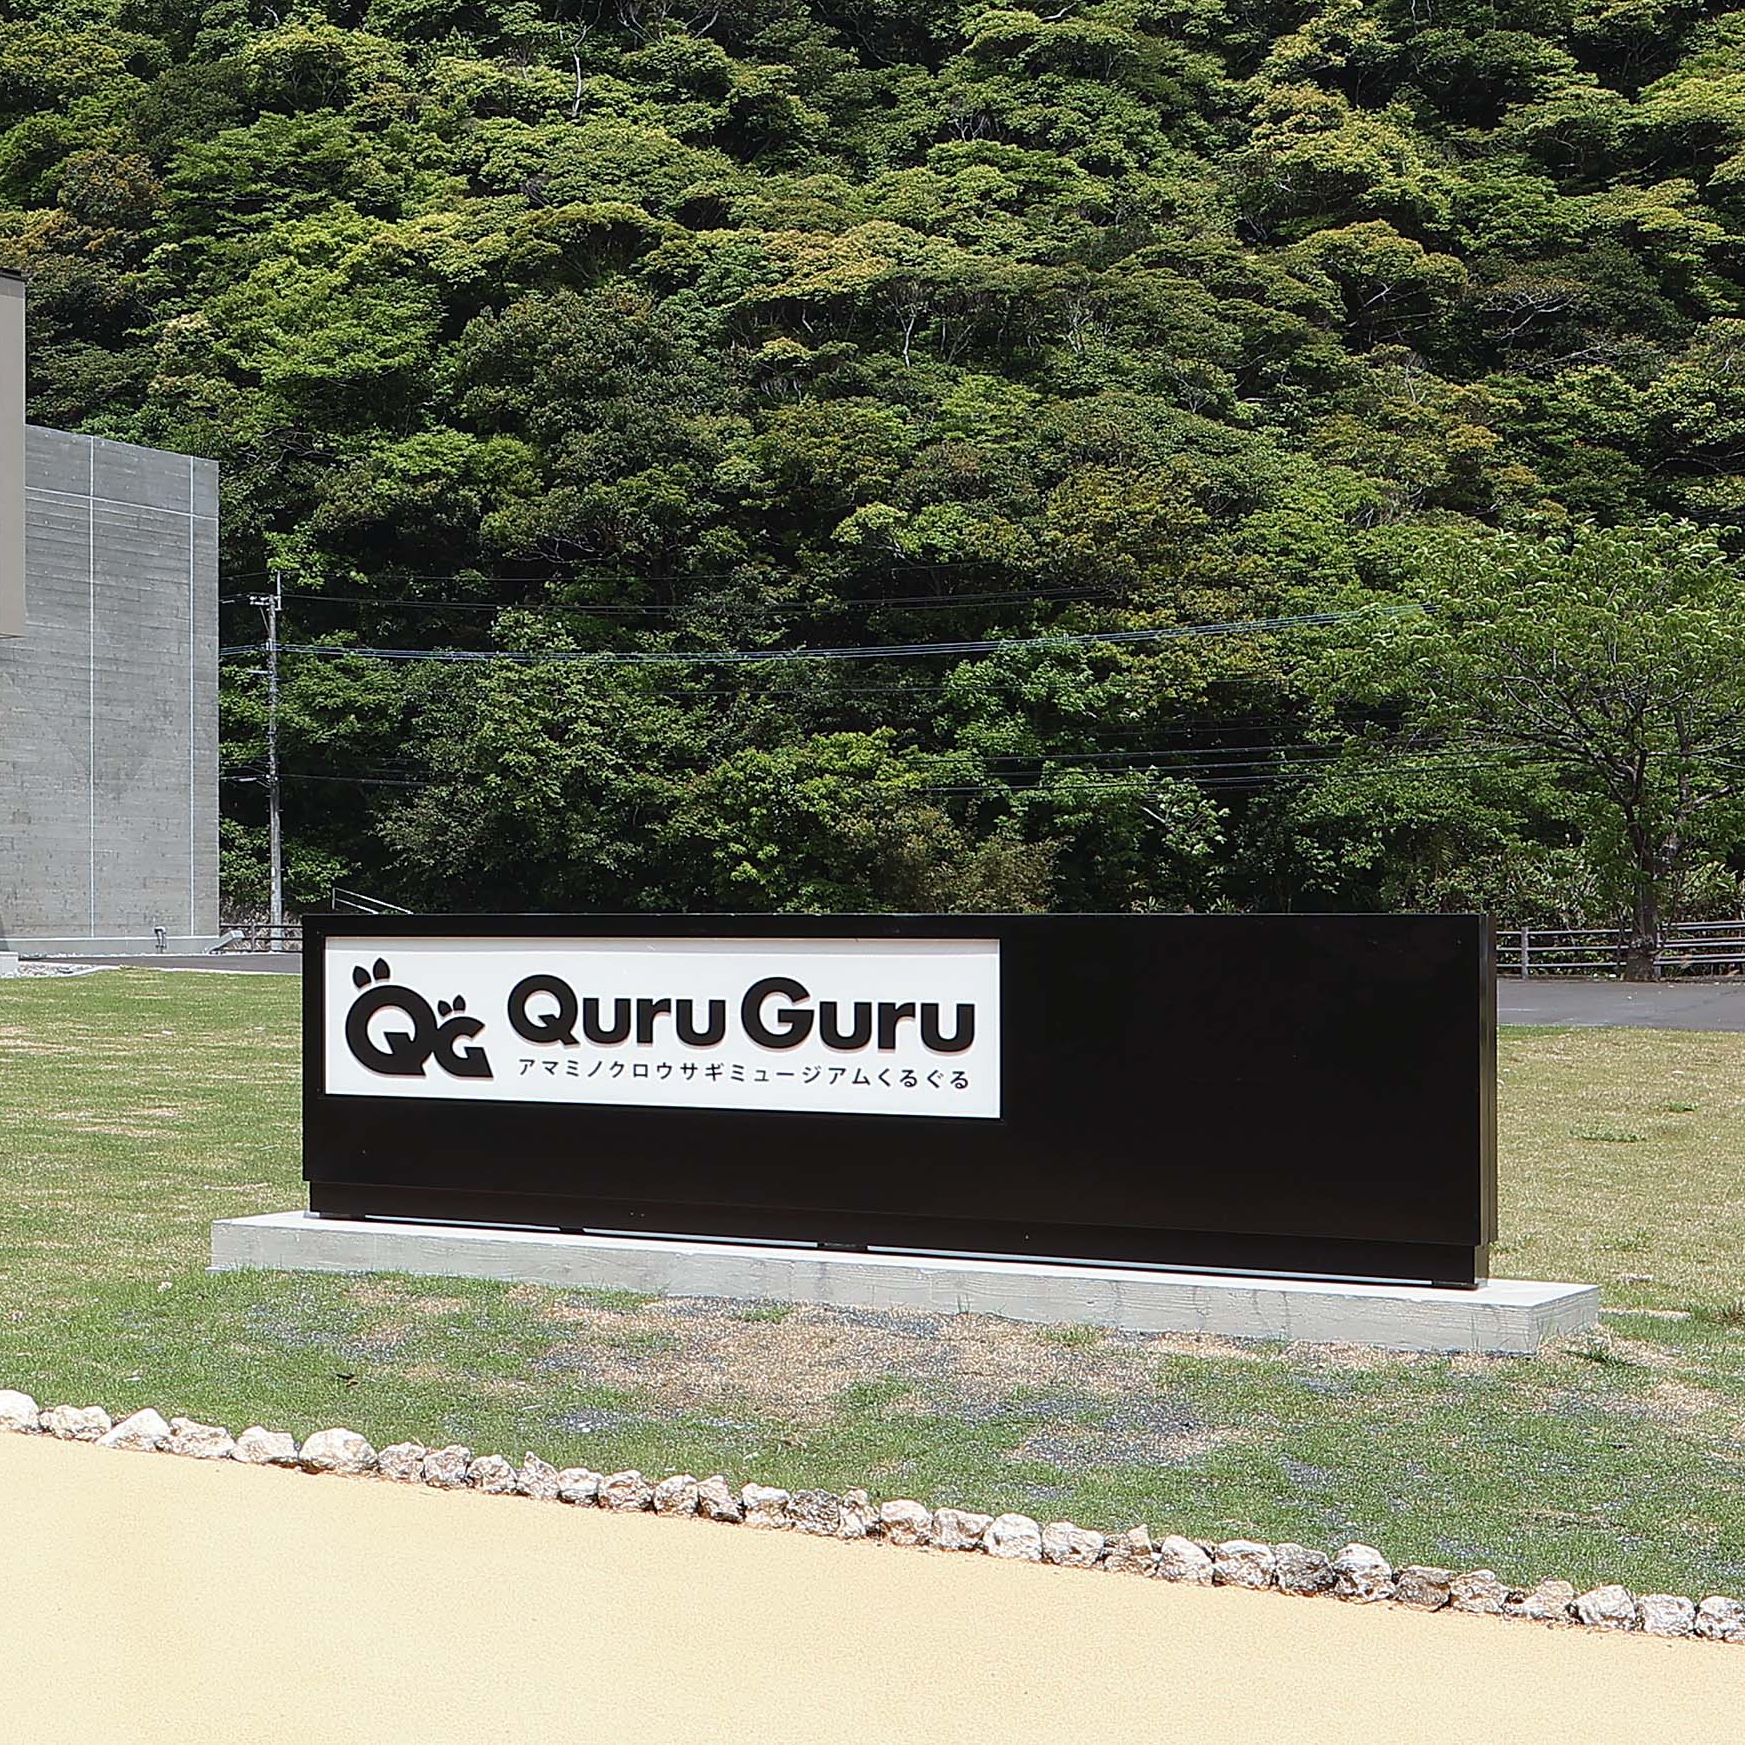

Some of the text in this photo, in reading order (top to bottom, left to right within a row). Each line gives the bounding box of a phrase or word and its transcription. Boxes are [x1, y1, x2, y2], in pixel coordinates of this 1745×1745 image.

[508, 975, 725, 1047] Quru
[741, 977, 974, 1052] Guru
[519, 1058, 969, 1090] アマミノクロウサギミュージアムくるぐる
